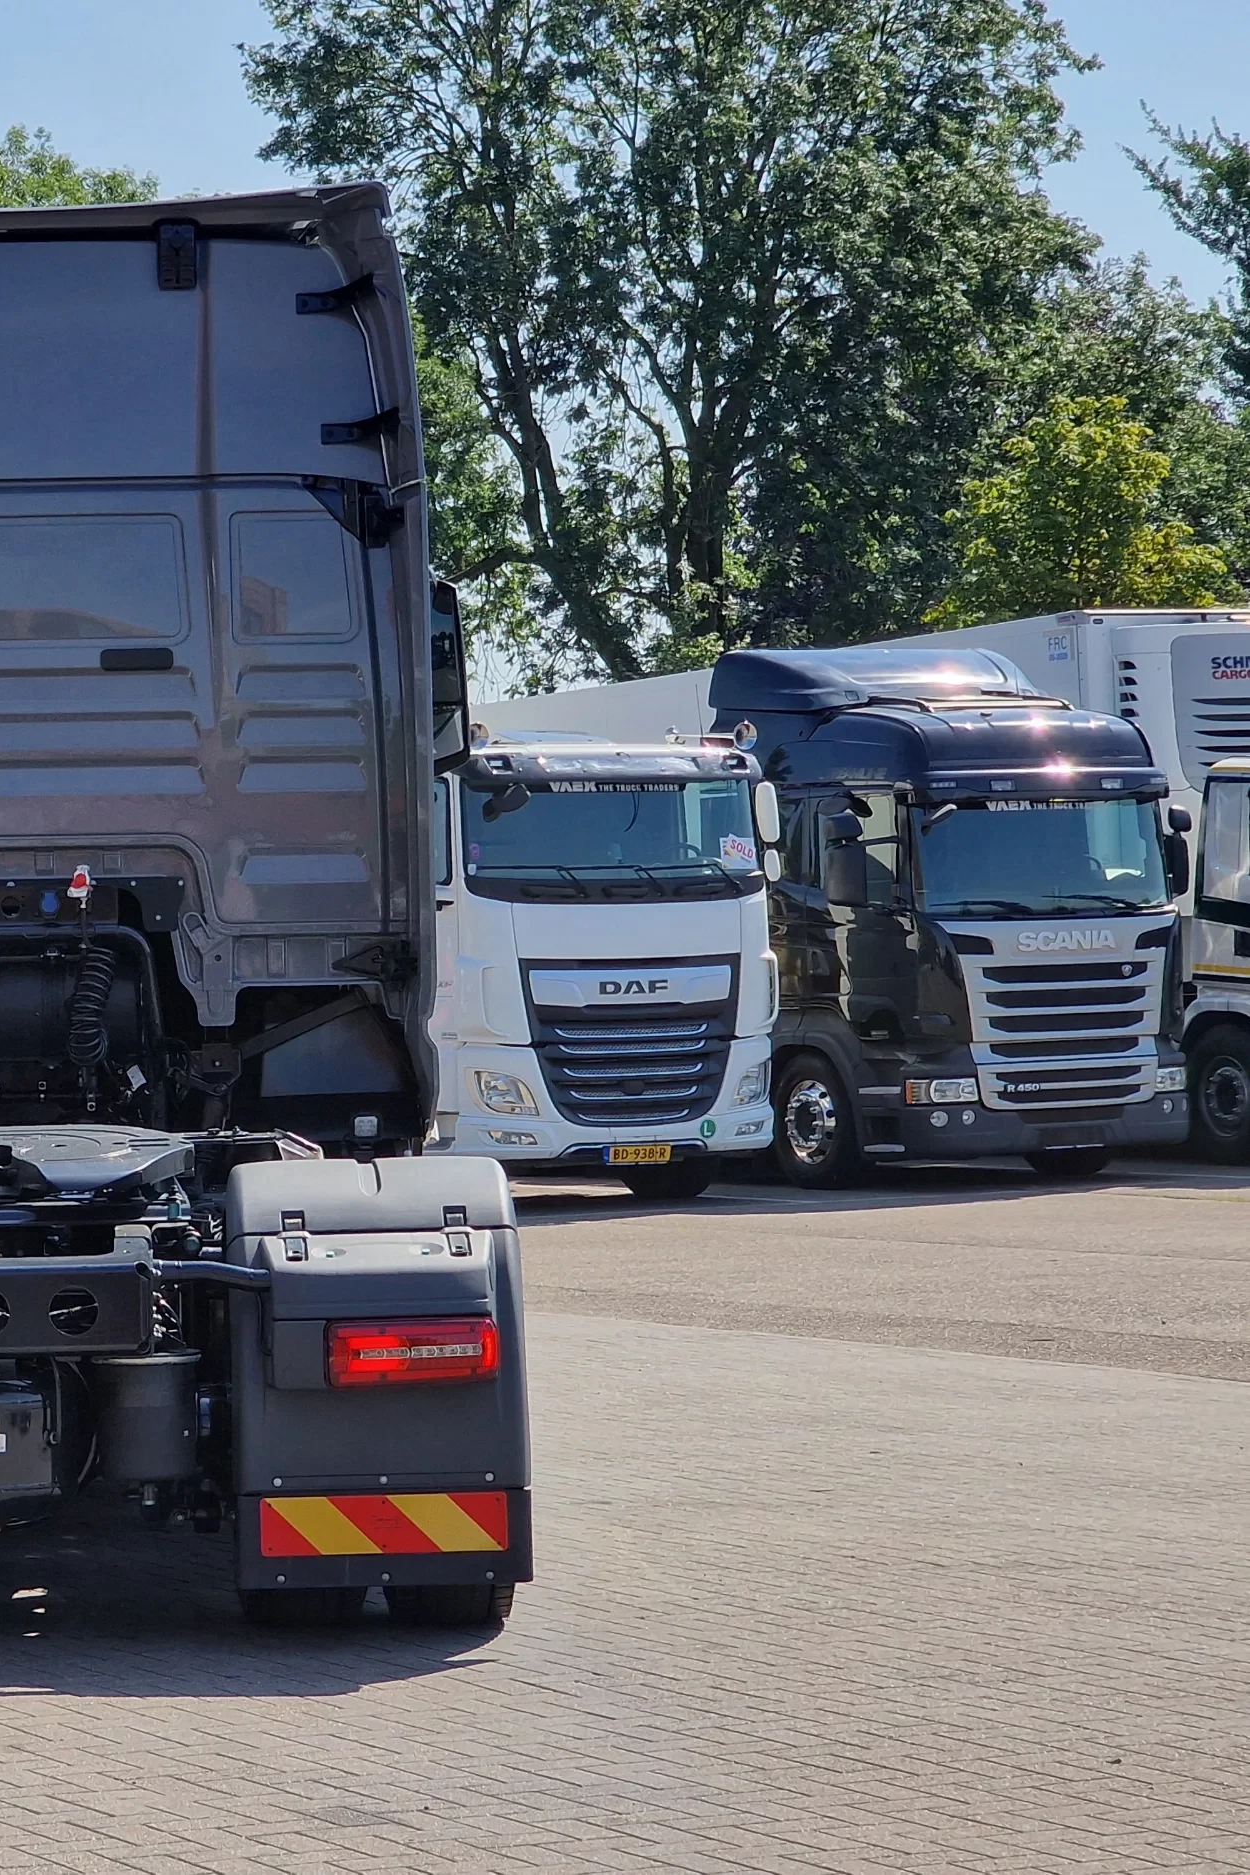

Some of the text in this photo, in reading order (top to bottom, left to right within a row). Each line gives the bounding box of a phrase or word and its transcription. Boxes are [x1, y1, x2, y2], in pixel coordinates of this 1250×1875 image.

[549, 781, 679, 793] VAEX THE TRUCK TRADERS
[730, 839, 754, 859] SOLD
[1017, 929, 1116, 952] SCANIA
[599, 979, 669, 995] DAF
[1007, 1083, 1040, 1093] R 450
